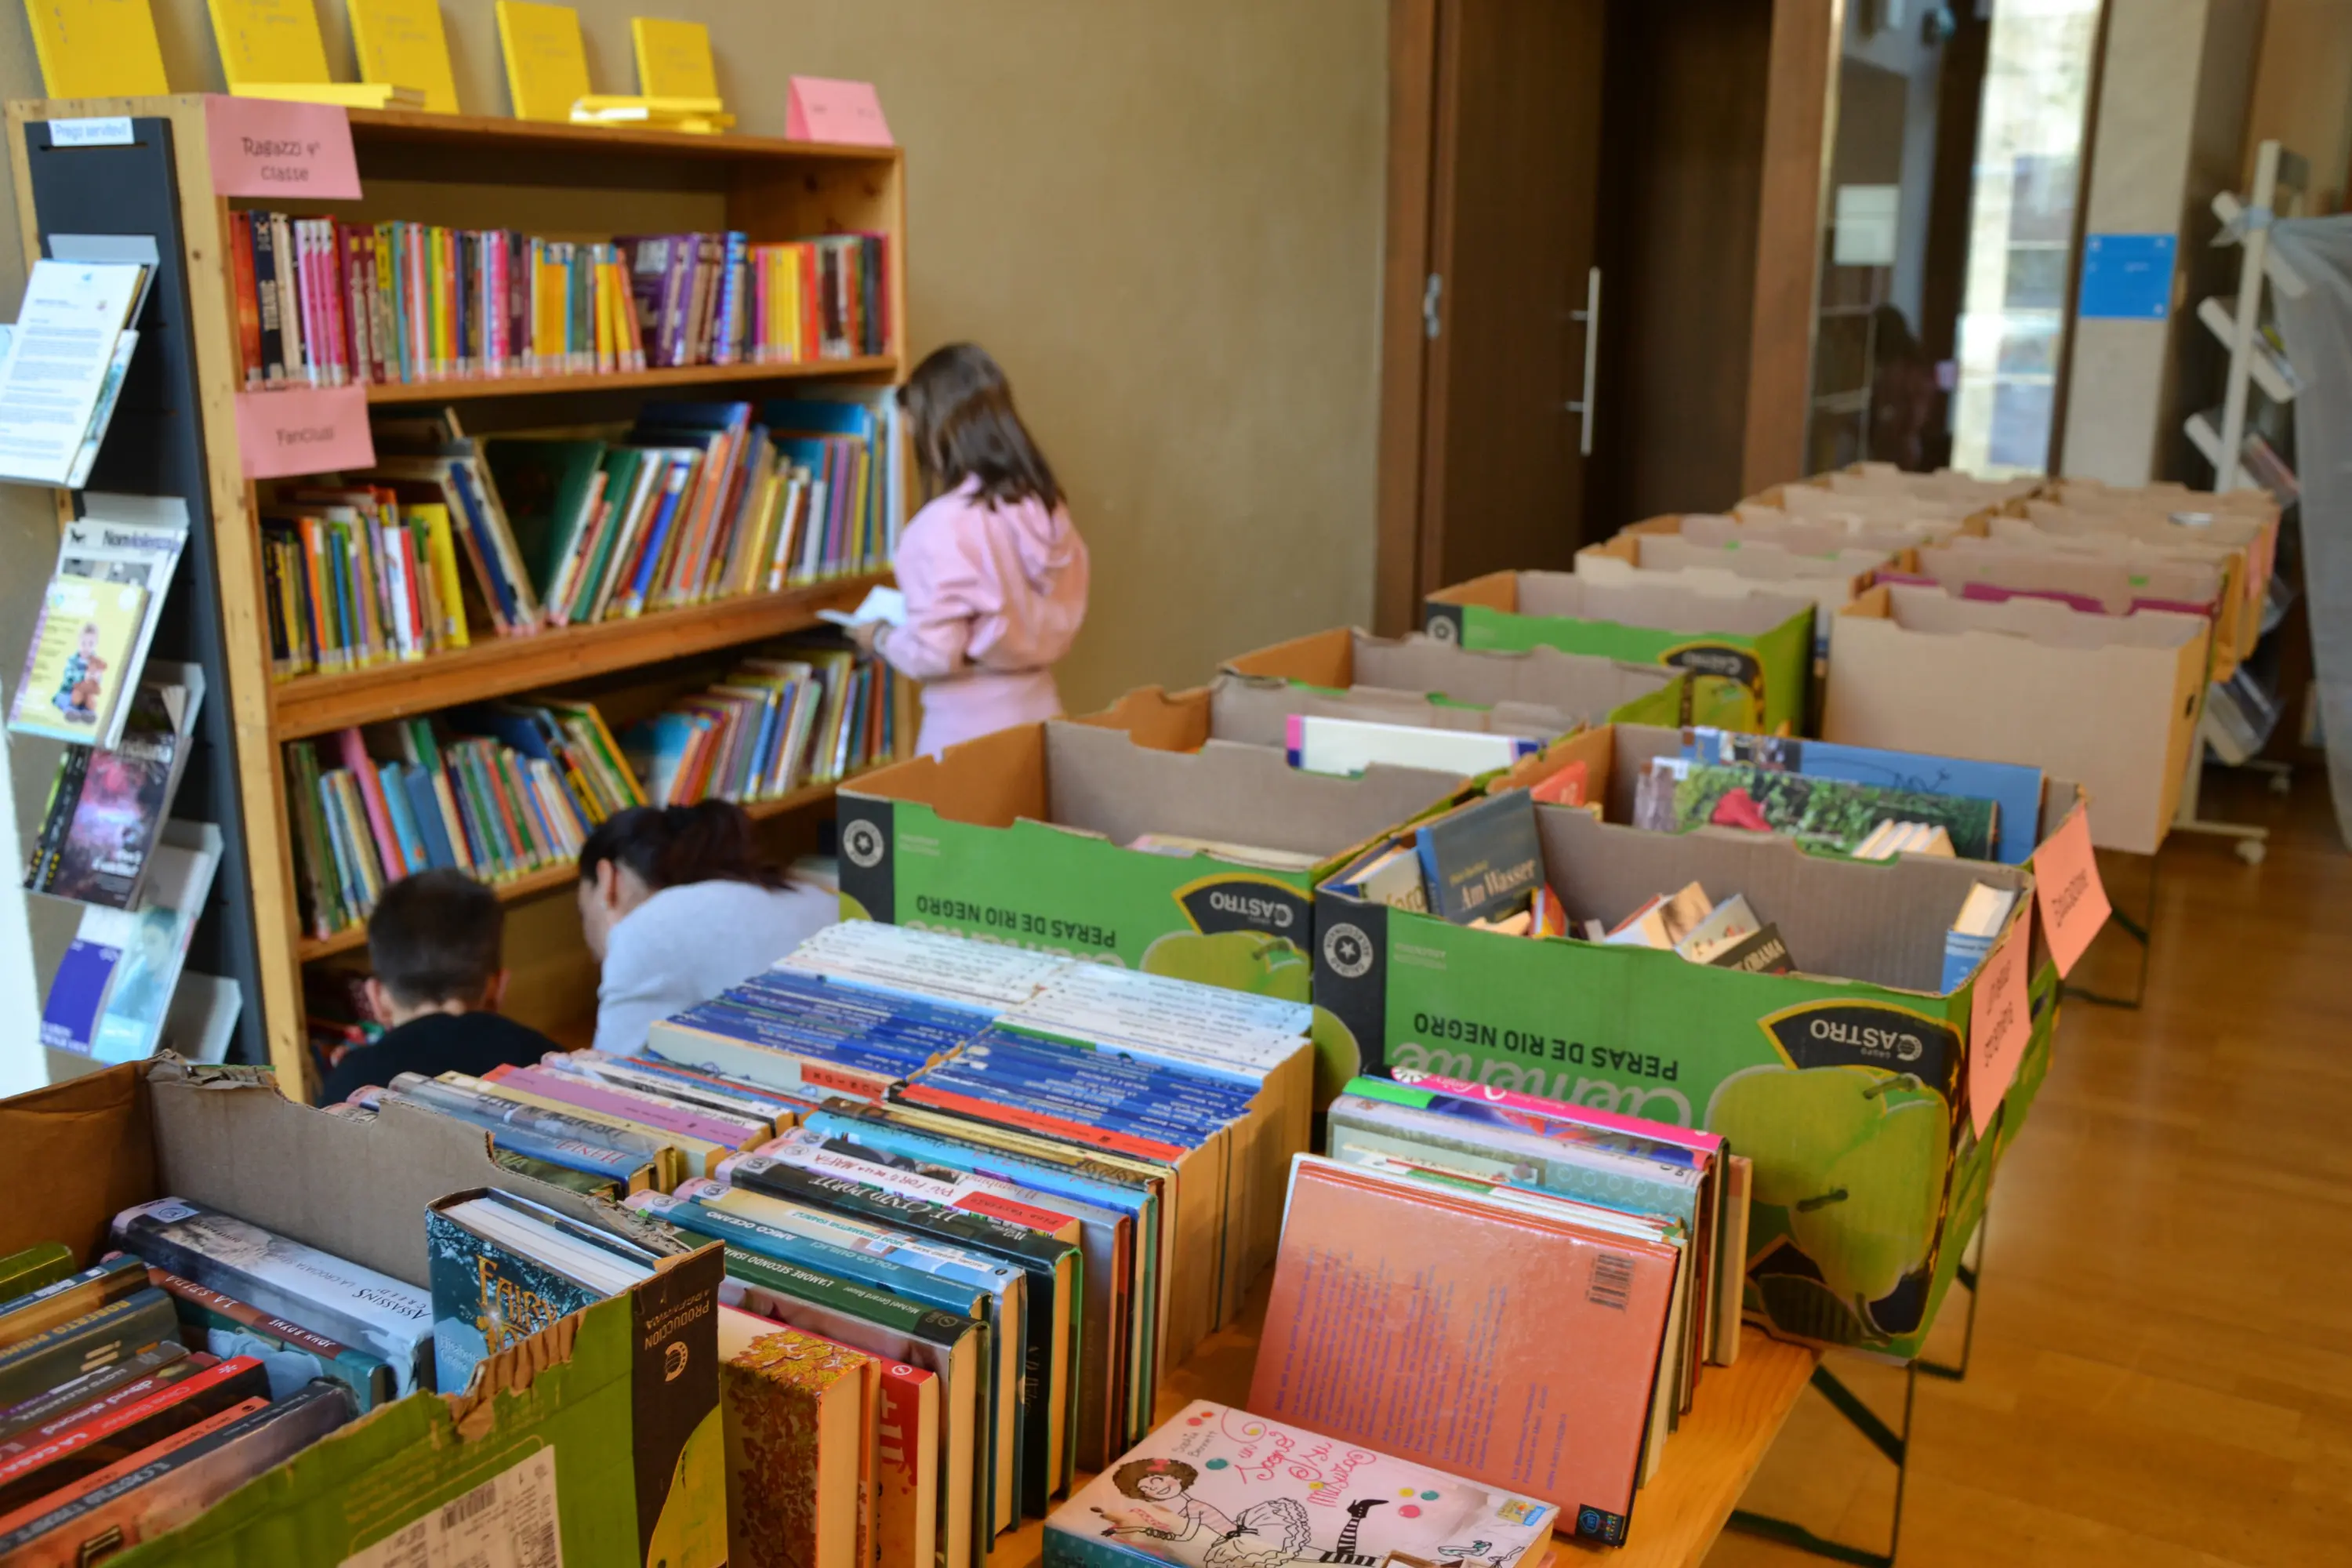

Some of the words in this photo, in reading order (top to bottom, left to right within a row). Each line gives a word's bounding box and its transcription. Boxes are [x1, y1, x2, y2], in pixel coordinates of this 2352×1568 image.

[916, 894, 982, 924] NEGRO
[985, 906, 1018, 931] RIO
[1209, 891, 1294, 928] CASTRO
[1021, 913, 1047, 935] DE
[1051, 918, 1116, 949] PERAS
[1414, 1011, 1497, 1048] NEGRO
[1809, 1018, 1923, 1062] CASTRO
[1503, 1029, 1545, 1058] RIO
[1551, 1038, 1584, 1065] DE
[1591, 1047, 1679, 1082] PERAS
[814, 1154, 860, 1174] MAFIA
[706, 1210, 757, 1230] OCEANO
[757, 1225, 798, 1241] AMICO
[724, 1247, 746, 1262] ISMA
[747, 1256, 793, 1277] SECONDO
[164, 1274, 216, 1298] SFIDA
[790, 1269, 836, 1288] L'AMORE
[214, 1294, 239, 1309] LA
[891, 1299, 921, 1315] Michael
[267, 1318, 306, 1337] BOYNE
[644, 1300, 710, 1351] PRODUCCION
[303, 1334, 337, 1348] JOHN
